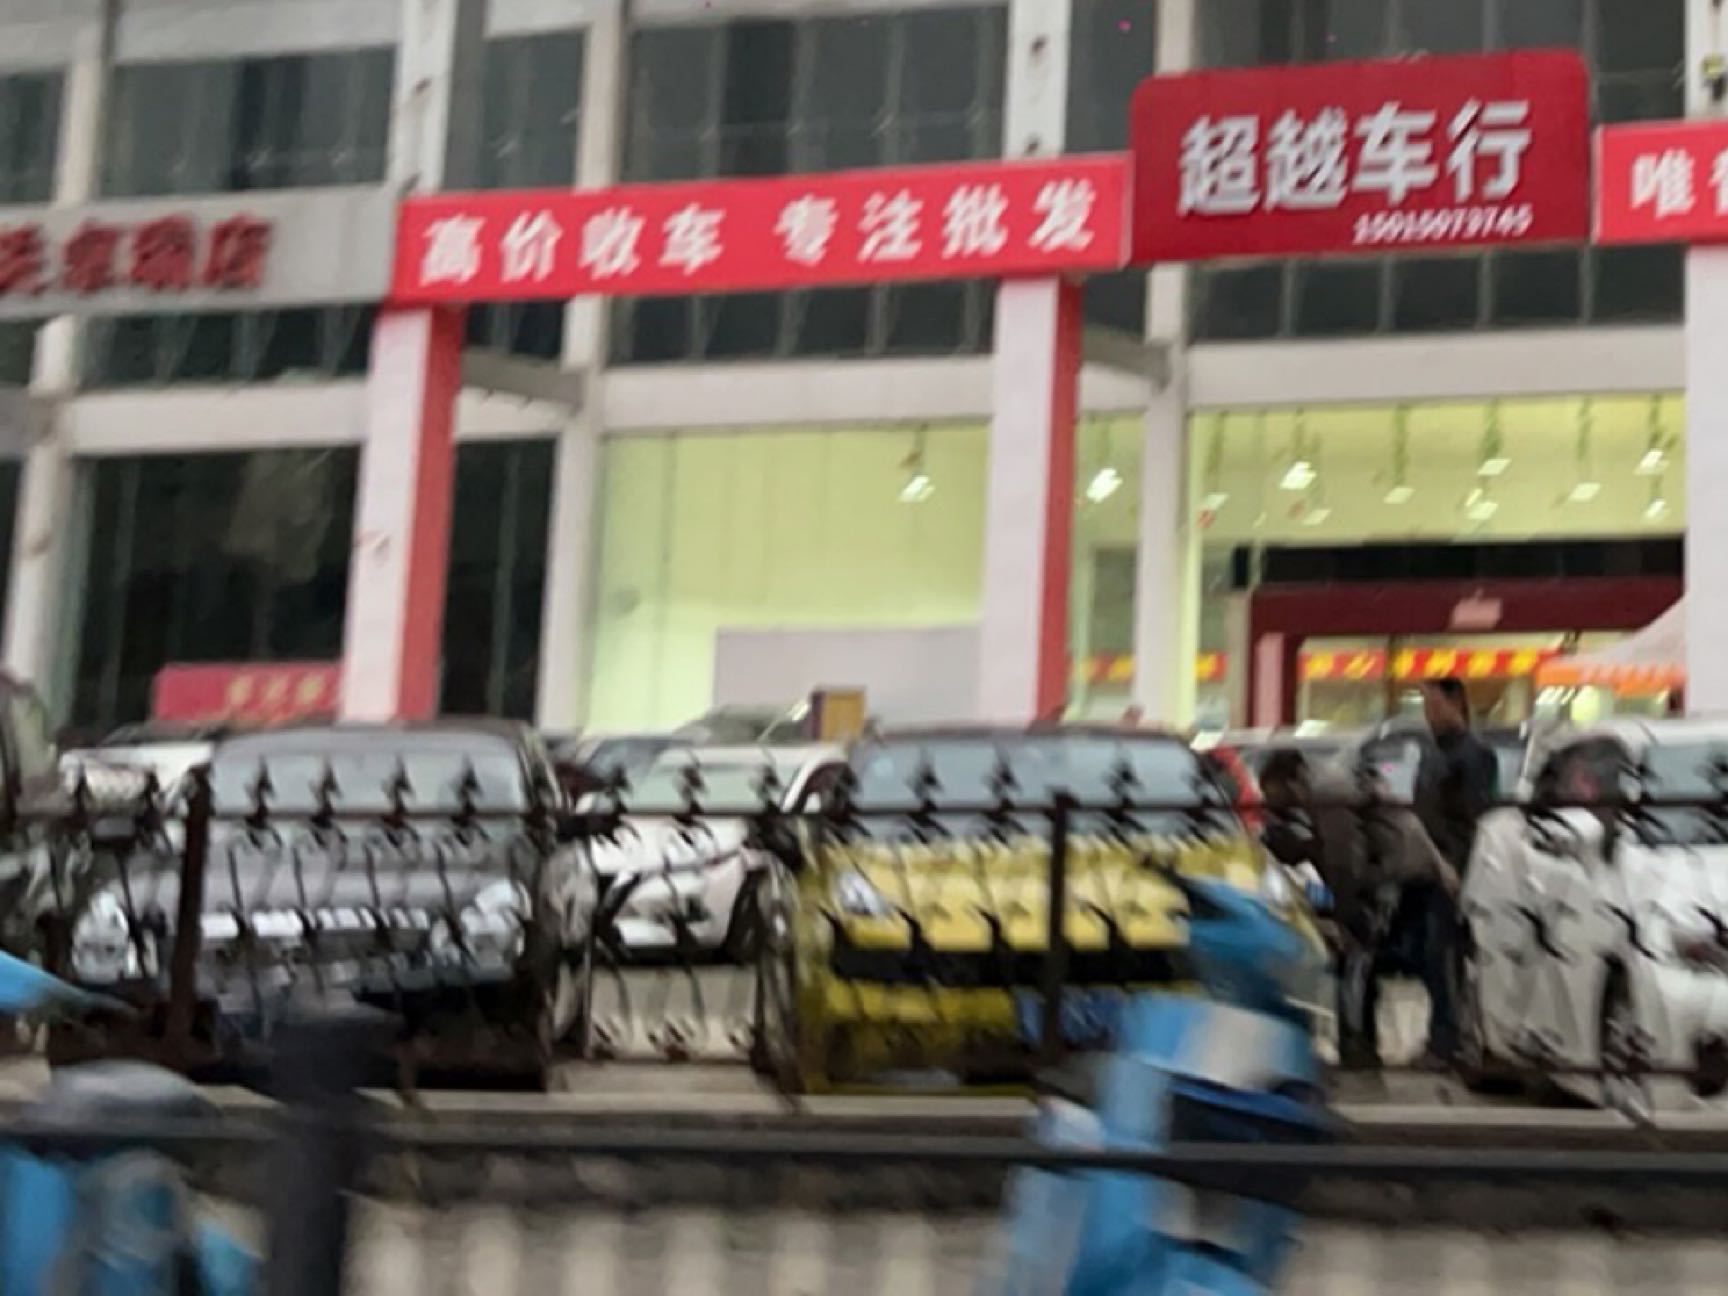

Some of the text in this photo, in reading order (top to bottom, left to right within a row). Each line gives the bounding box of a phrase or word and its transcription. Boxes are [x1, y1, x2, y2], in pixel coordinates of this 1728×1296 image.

[1177, 95, 1532, 217] 超越车行
[418, 177, 1098, 287] 高价收车 专注批发
